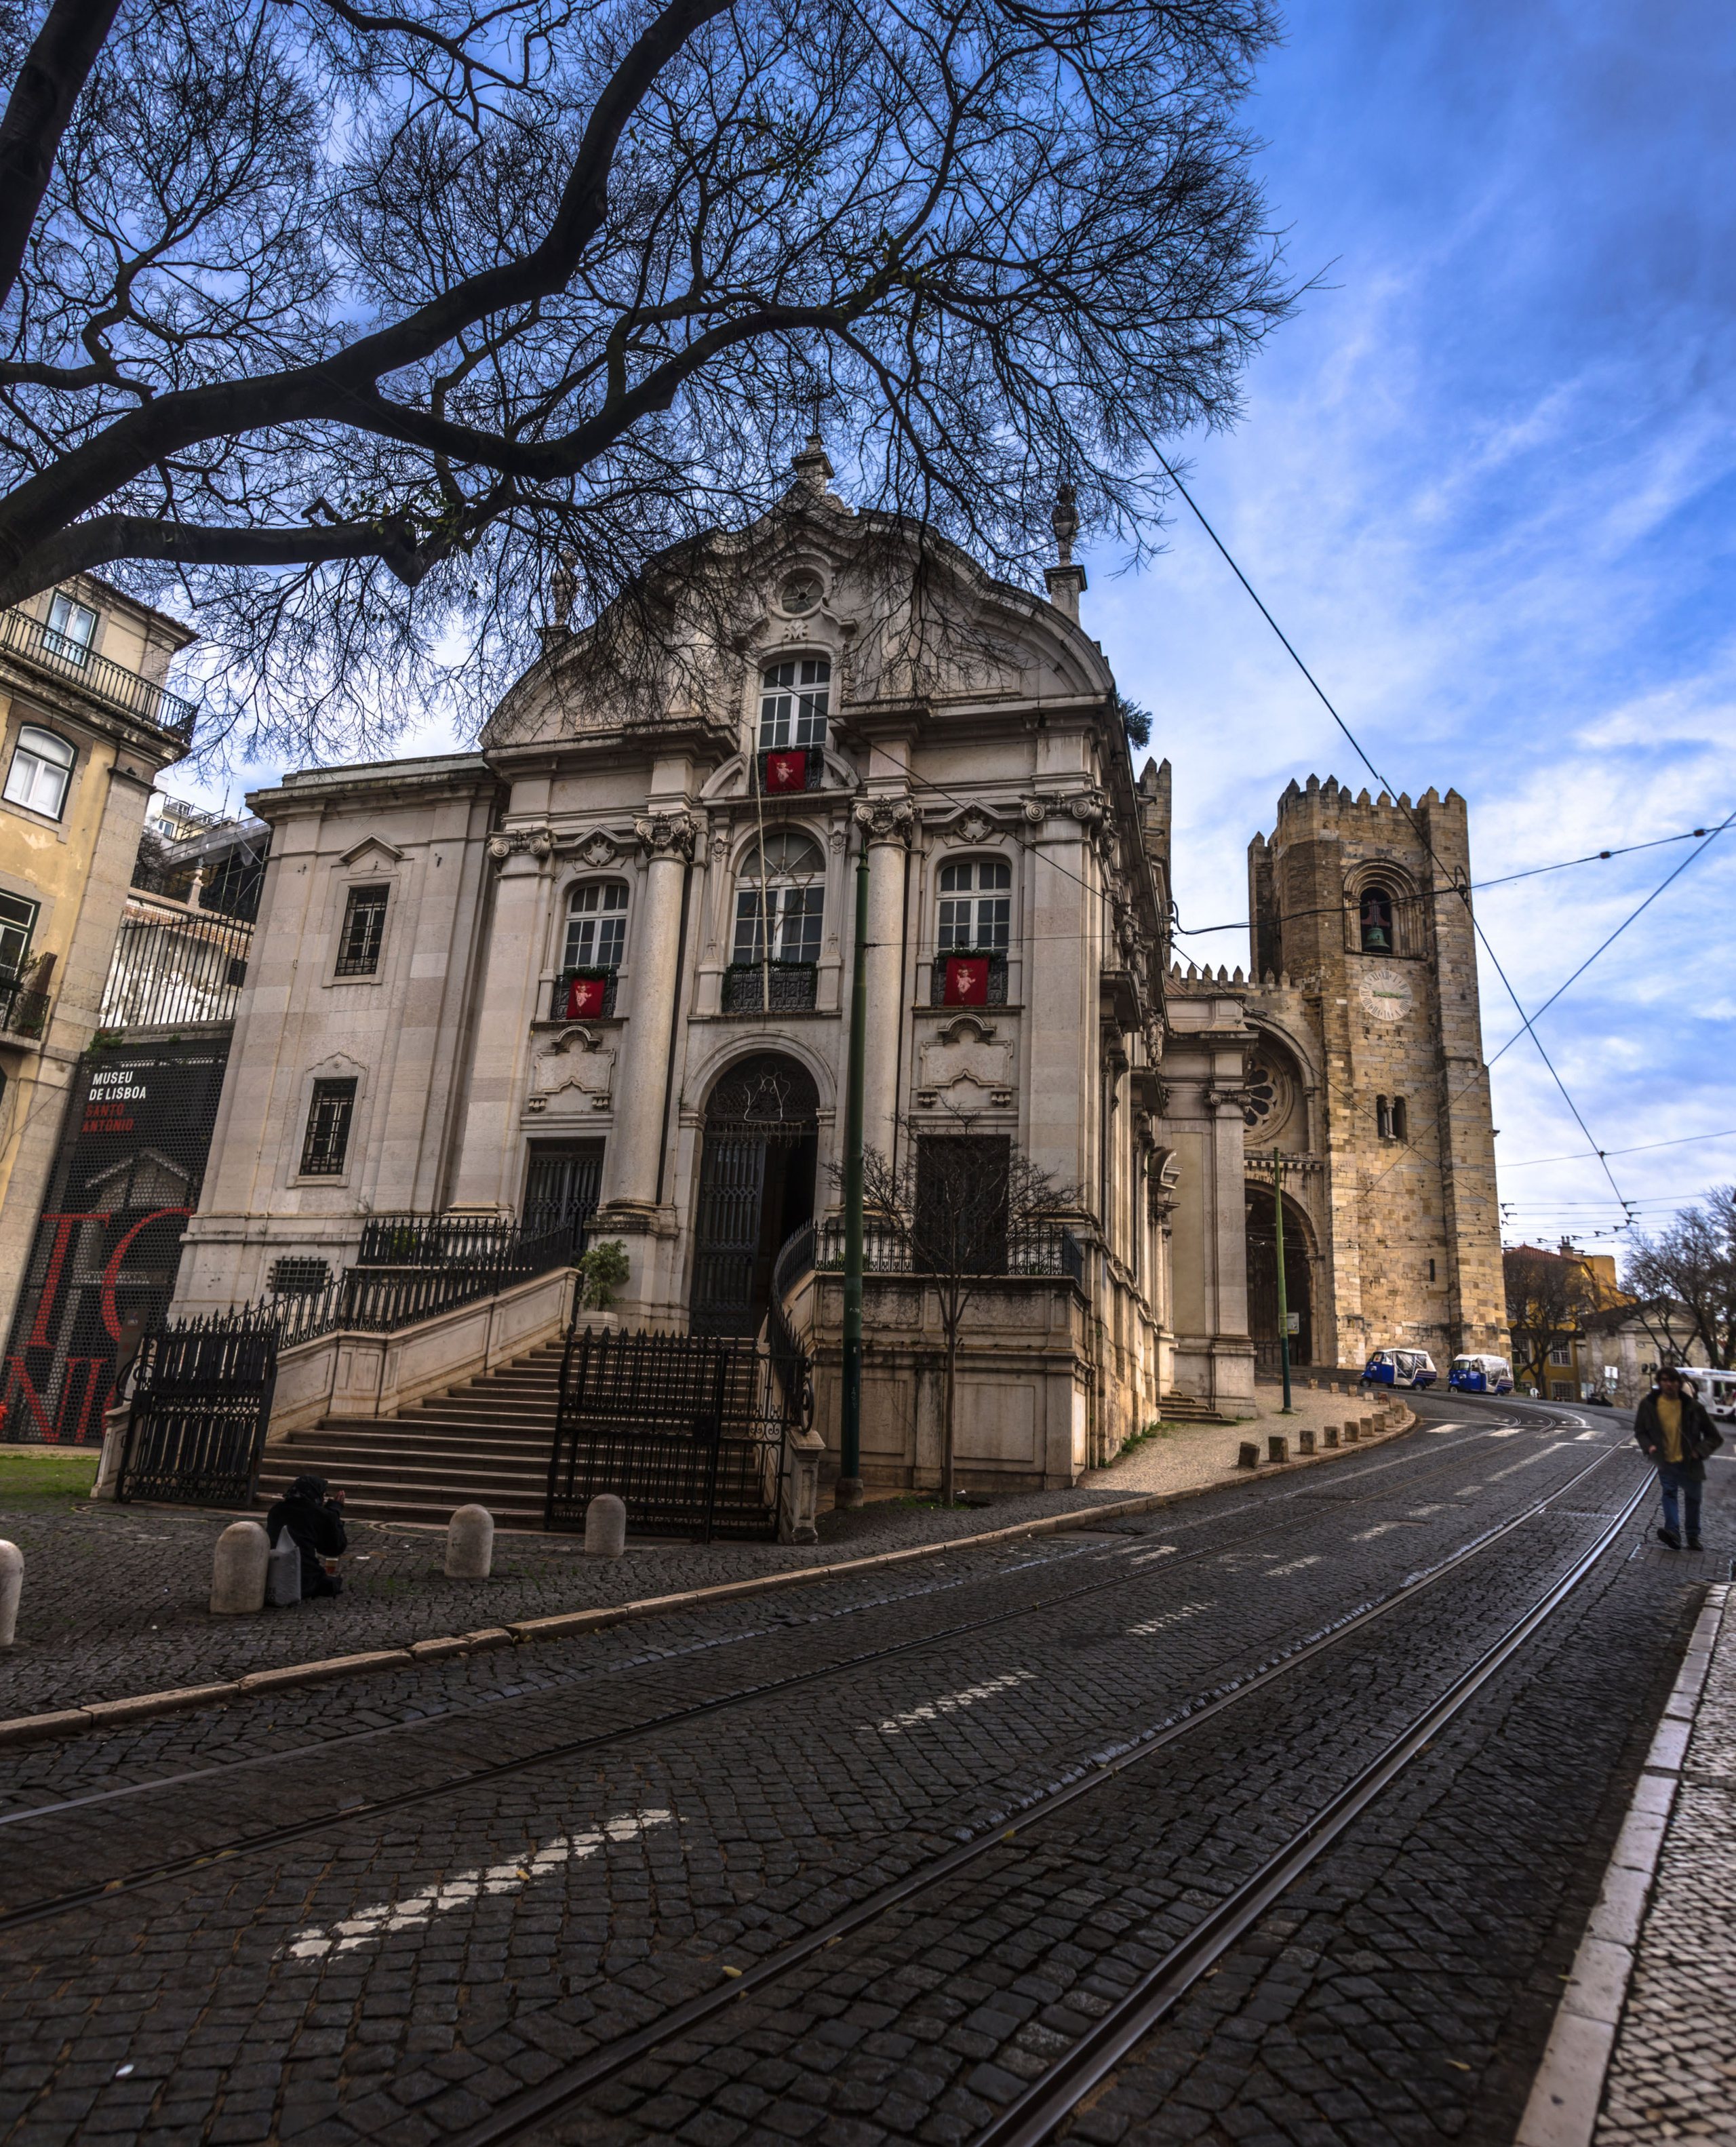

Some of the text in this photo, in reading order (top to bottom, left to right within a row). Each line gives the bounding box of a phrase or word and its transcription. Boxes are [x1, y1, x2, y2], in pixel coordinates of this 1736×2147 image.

[92, 1071, 134, 1085] MUSEU
[88, 1086, 146, 1101] DE LISBOA
[85, 1103, 124, 1117] SANTO
